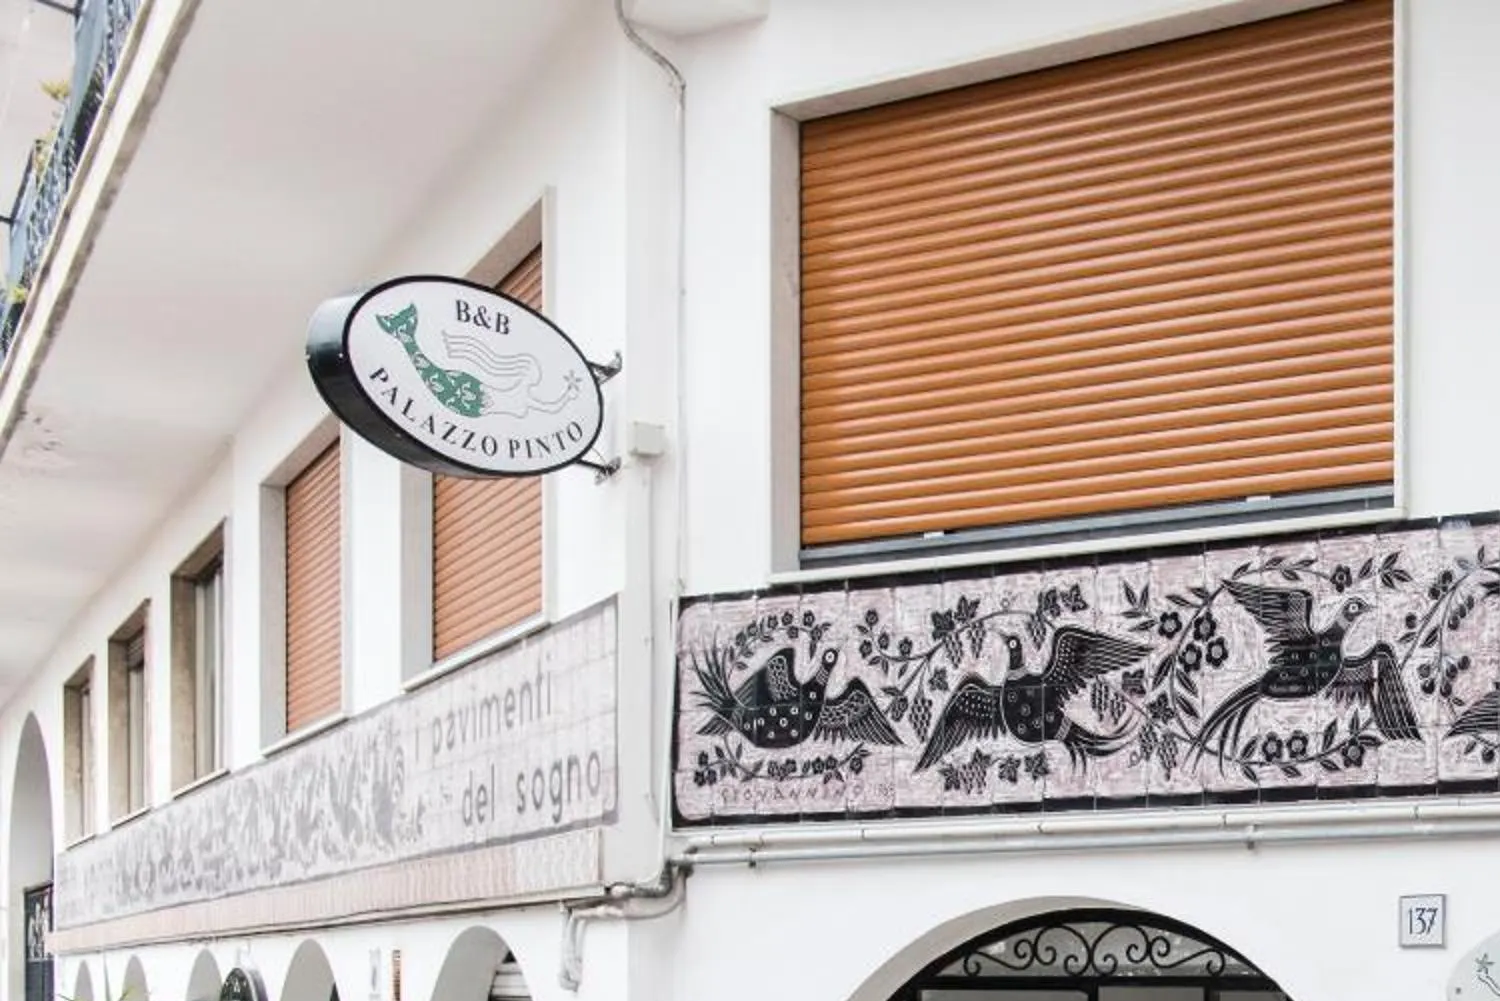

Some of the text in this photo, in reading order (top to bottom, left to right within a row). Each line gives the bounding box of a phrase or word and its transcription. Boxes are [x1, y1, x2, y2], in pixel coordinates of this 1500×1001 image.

[455, 299, 511, 336] B&B
[369, 367, 585, 459] PALAZZO PINTO
[432, 652, 552, 767] pavimenti
[462, 751, 601, 827] del sogno
[1408, 907, 1439, 935] 137
